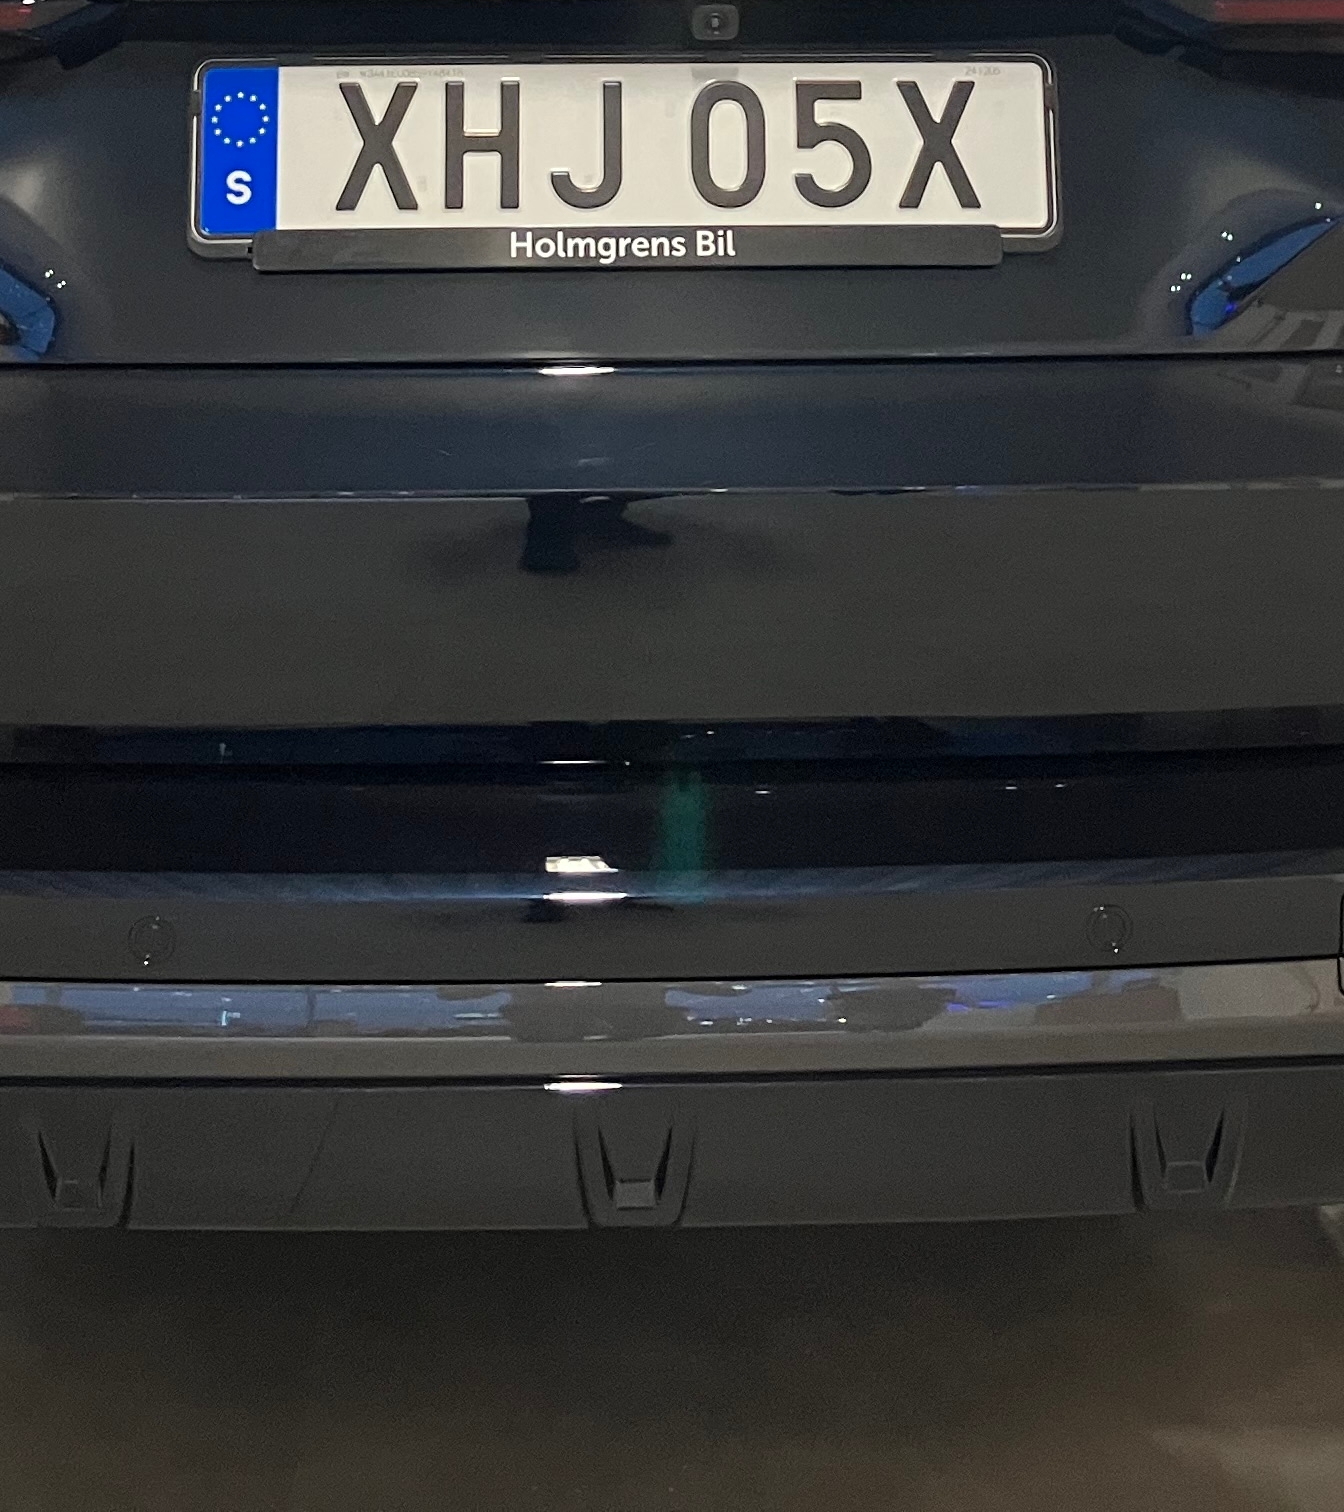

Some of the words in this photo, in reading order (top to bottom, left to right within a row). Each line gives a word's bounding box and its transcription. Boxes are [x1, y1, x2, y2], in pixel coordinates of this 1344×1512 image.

[335, 81, 624, 211] XHJ
[690, 80, 982, 210] 05X
[226, 170, 252, 205] S
[510, 230, 687, 264] Holmgrens
[695, 229, 737, 257] Bil
